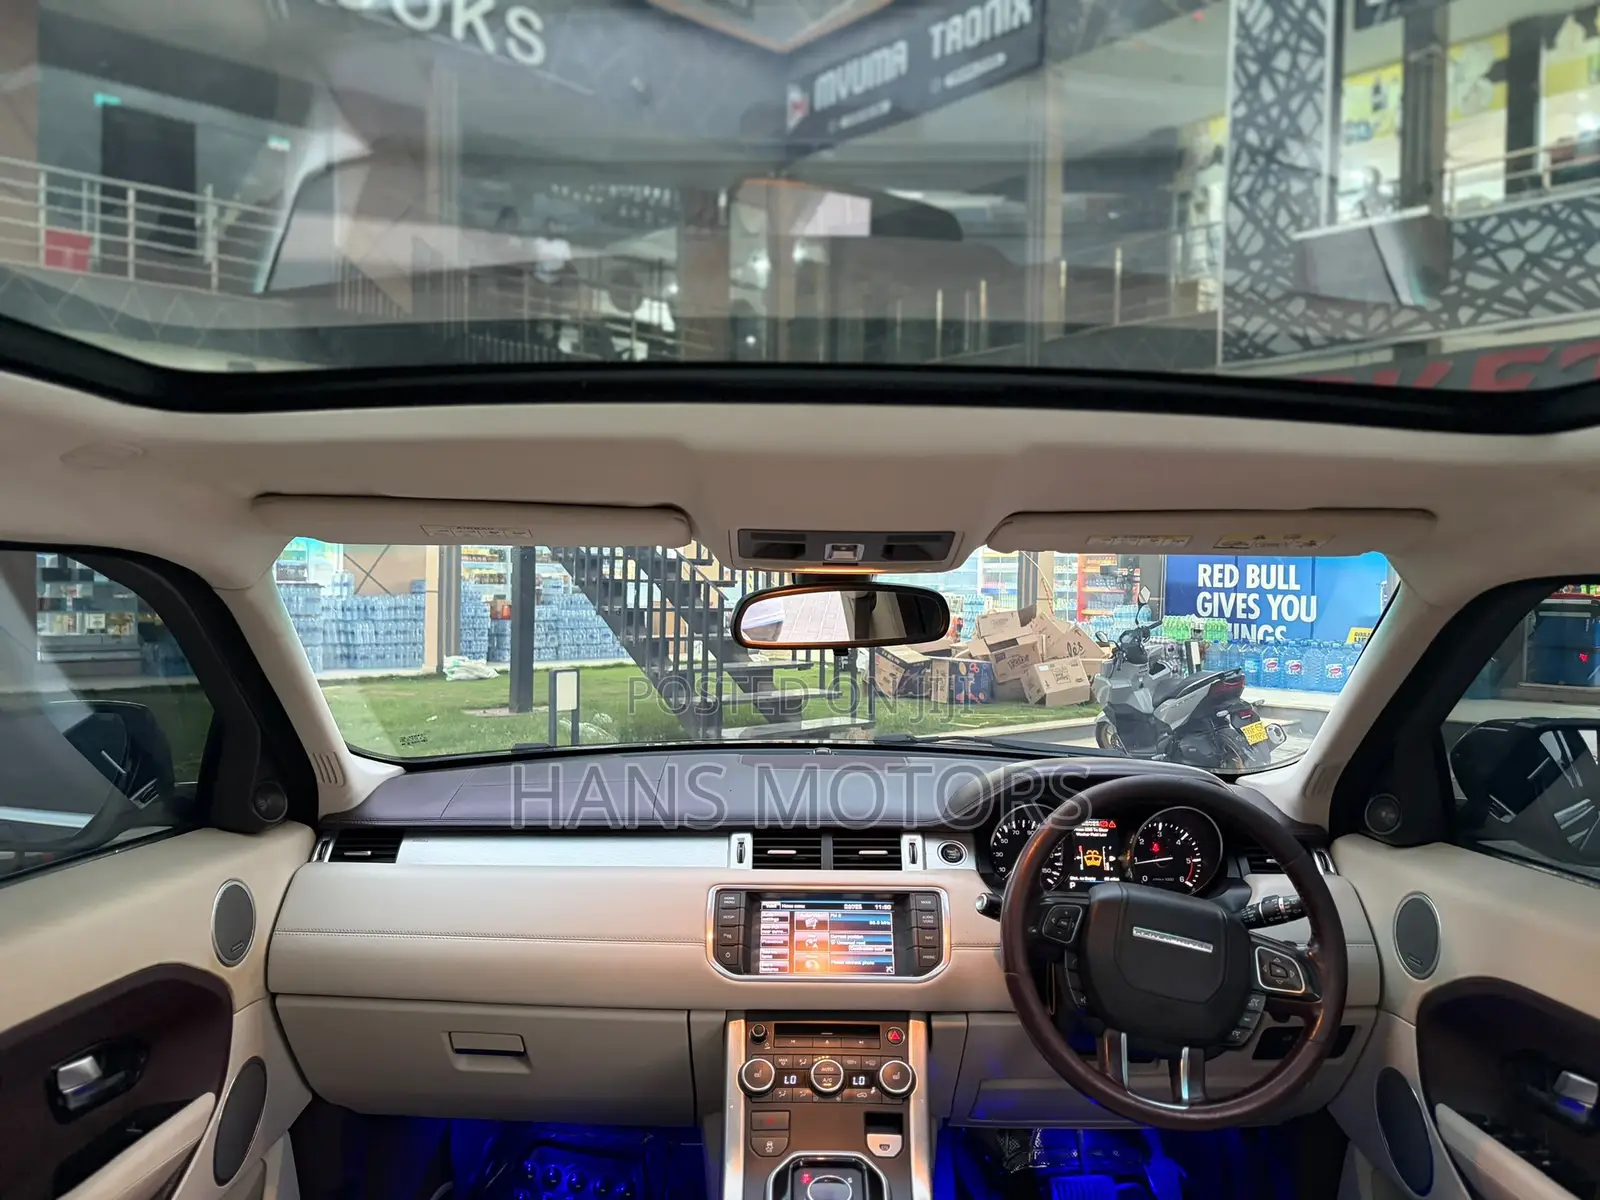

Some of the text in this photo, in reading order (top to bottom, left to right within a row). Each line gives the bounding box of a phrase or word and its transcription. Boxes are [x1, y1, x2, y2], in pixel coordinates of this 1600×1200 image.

[928, 0, 1033, 60] TRONIX
[1197, 563, 1301, 591] RED BULL
[1196, 591, 1318, 623] GIVES YOU
[1230, 622, 1288, 644] INGS
[784, 1075, 797, 1085] LO
[852, 1076, 866, 1086] LO
